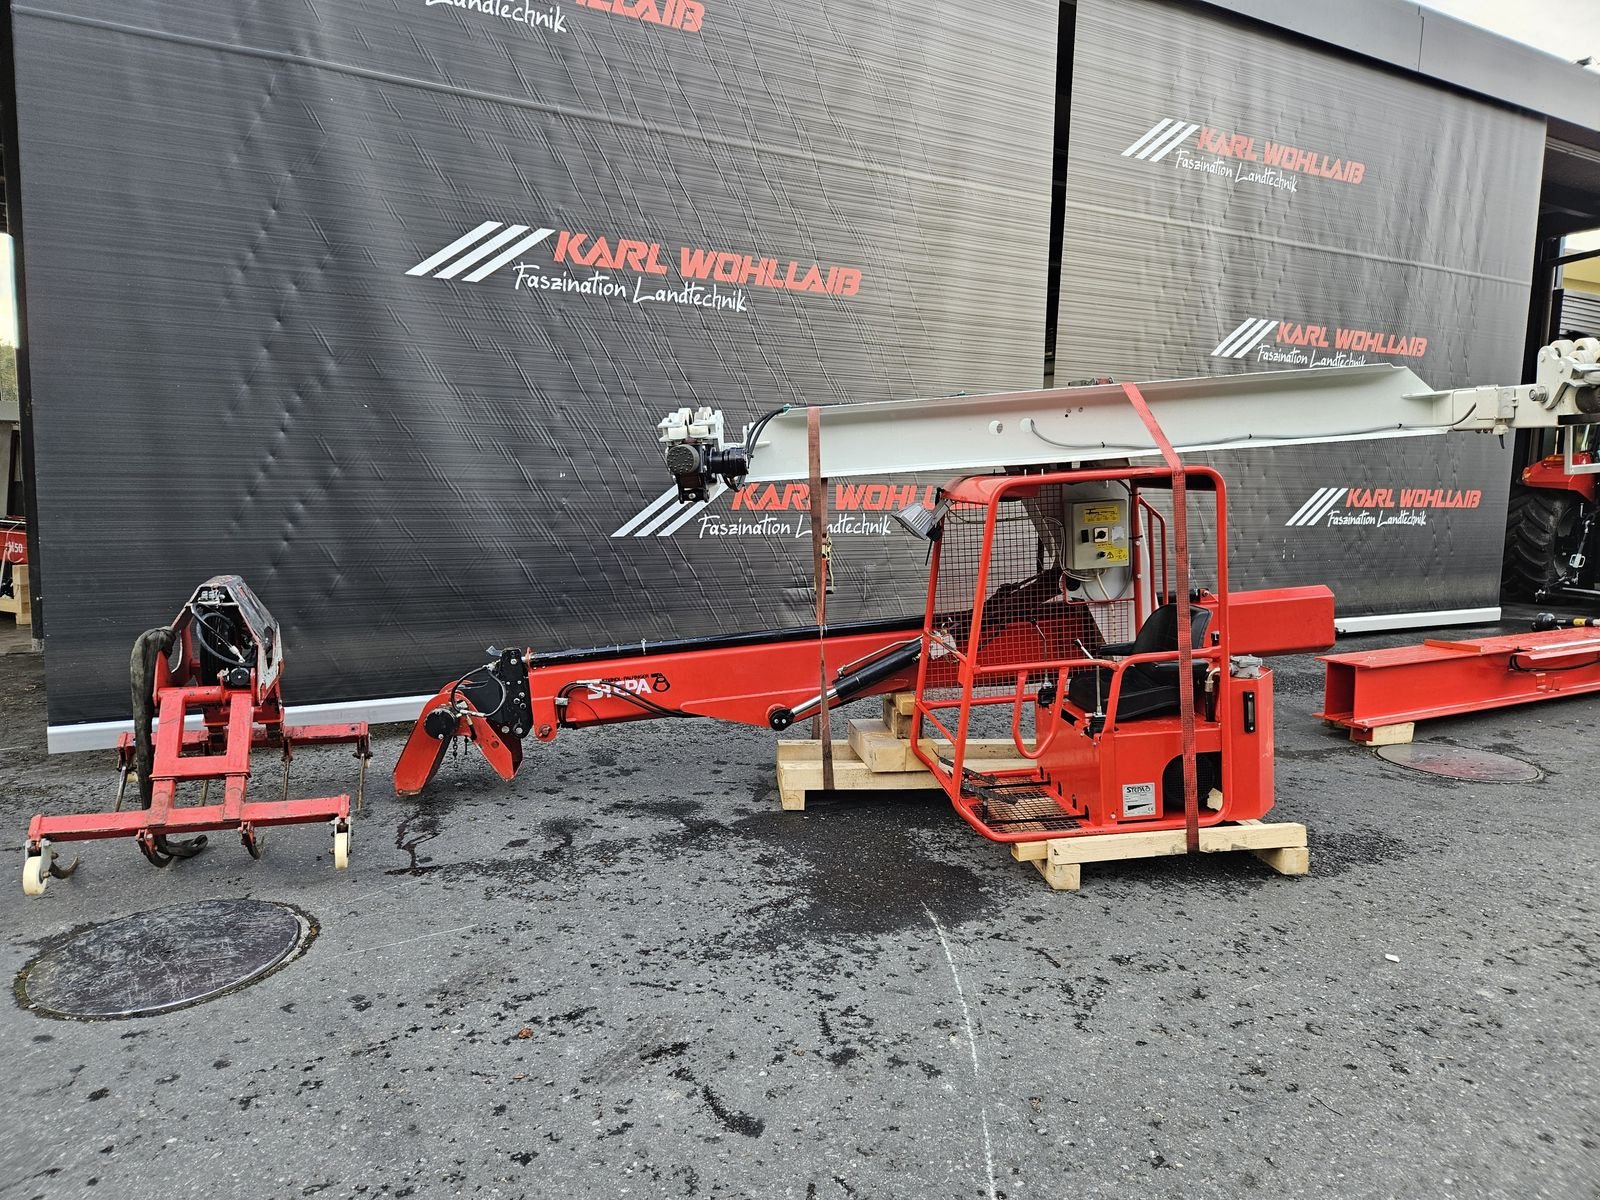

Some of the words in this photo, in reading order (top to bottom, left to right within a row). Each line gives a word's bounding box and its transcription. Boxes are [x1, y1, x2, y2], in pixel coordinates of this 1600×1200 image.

[1197, 126, 1257, 162] KARL
[1175, 148, 1233, 178] Faszination
[1235, 163, 1299, 192] Landtechnik
[553, 230, 669, 275] KARL
[512, 262, 627, 299] Faszination
[632, 276, 748, 312] Landtechnik
[1276, 321, 1330, 348] KARL
[1257, 343, 1308, 363] Faszination
[1345, 488, 1396, 508] KARL
[698, 513, 791, 539] Faszination
[795, 513, 892, 539] Lndtechnik
[1327, 509, 1376, 528] Faszination
[1377, 510, 1426, 528] Landtechnik
[587, 679, 651, 700] STEPA
